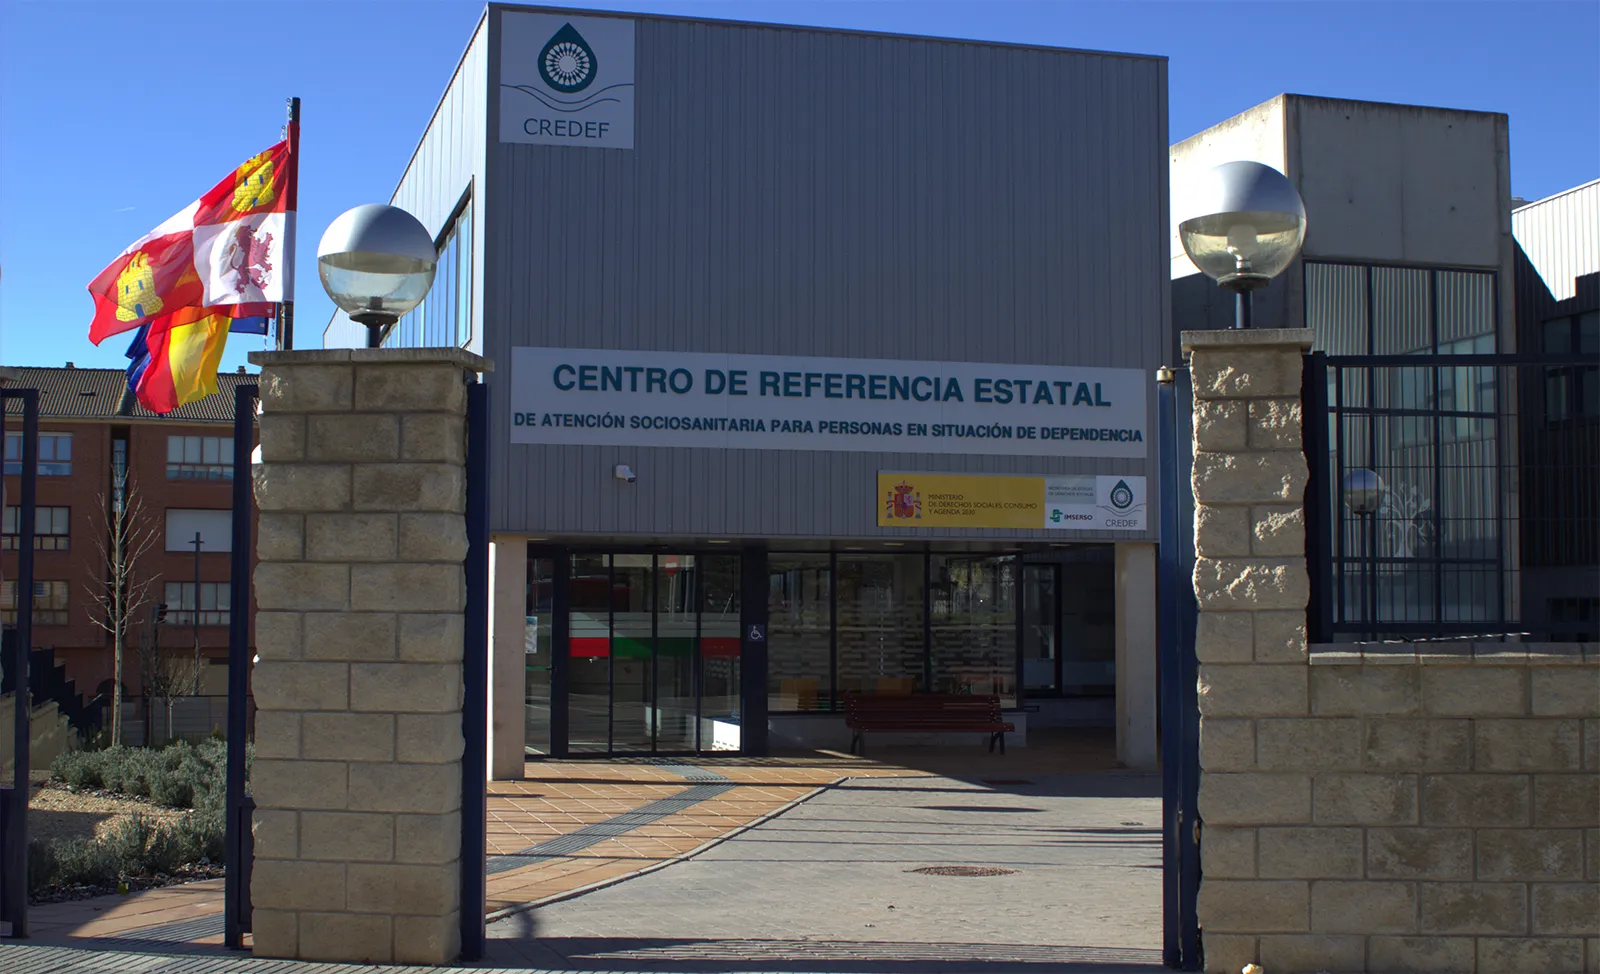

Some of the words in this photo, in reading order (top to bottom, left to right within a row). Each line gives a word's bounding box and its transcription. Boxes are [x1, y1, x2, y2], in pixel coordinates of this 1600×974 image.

[523, 118, 610, 138] CREDEF
[553, 364, 693, 394] CENTRO
[705, 369, 748, 395] DE
[759, 372, 964, 402] REFERENCIA
[974, 378, 1112, 407] ESTATAL
[514, 412, 536, 426] DE
[541, 412, 625, 429] ATENCIÓN
[630, 415, 766, 432] SOCIOSANITARIA
[771, 419, 814, 433] PARA
[819, 421, 902, 436] PERSONAS
[907, 424, 928, 437] EN
[931, 422, 1011, 439] SITUACIÓN
[1016, 426, 1037, 439] DE
[1041, 427, 1143, 442] DEPENDENCIA
[1105, 519, 1138, 528] CREDEF
